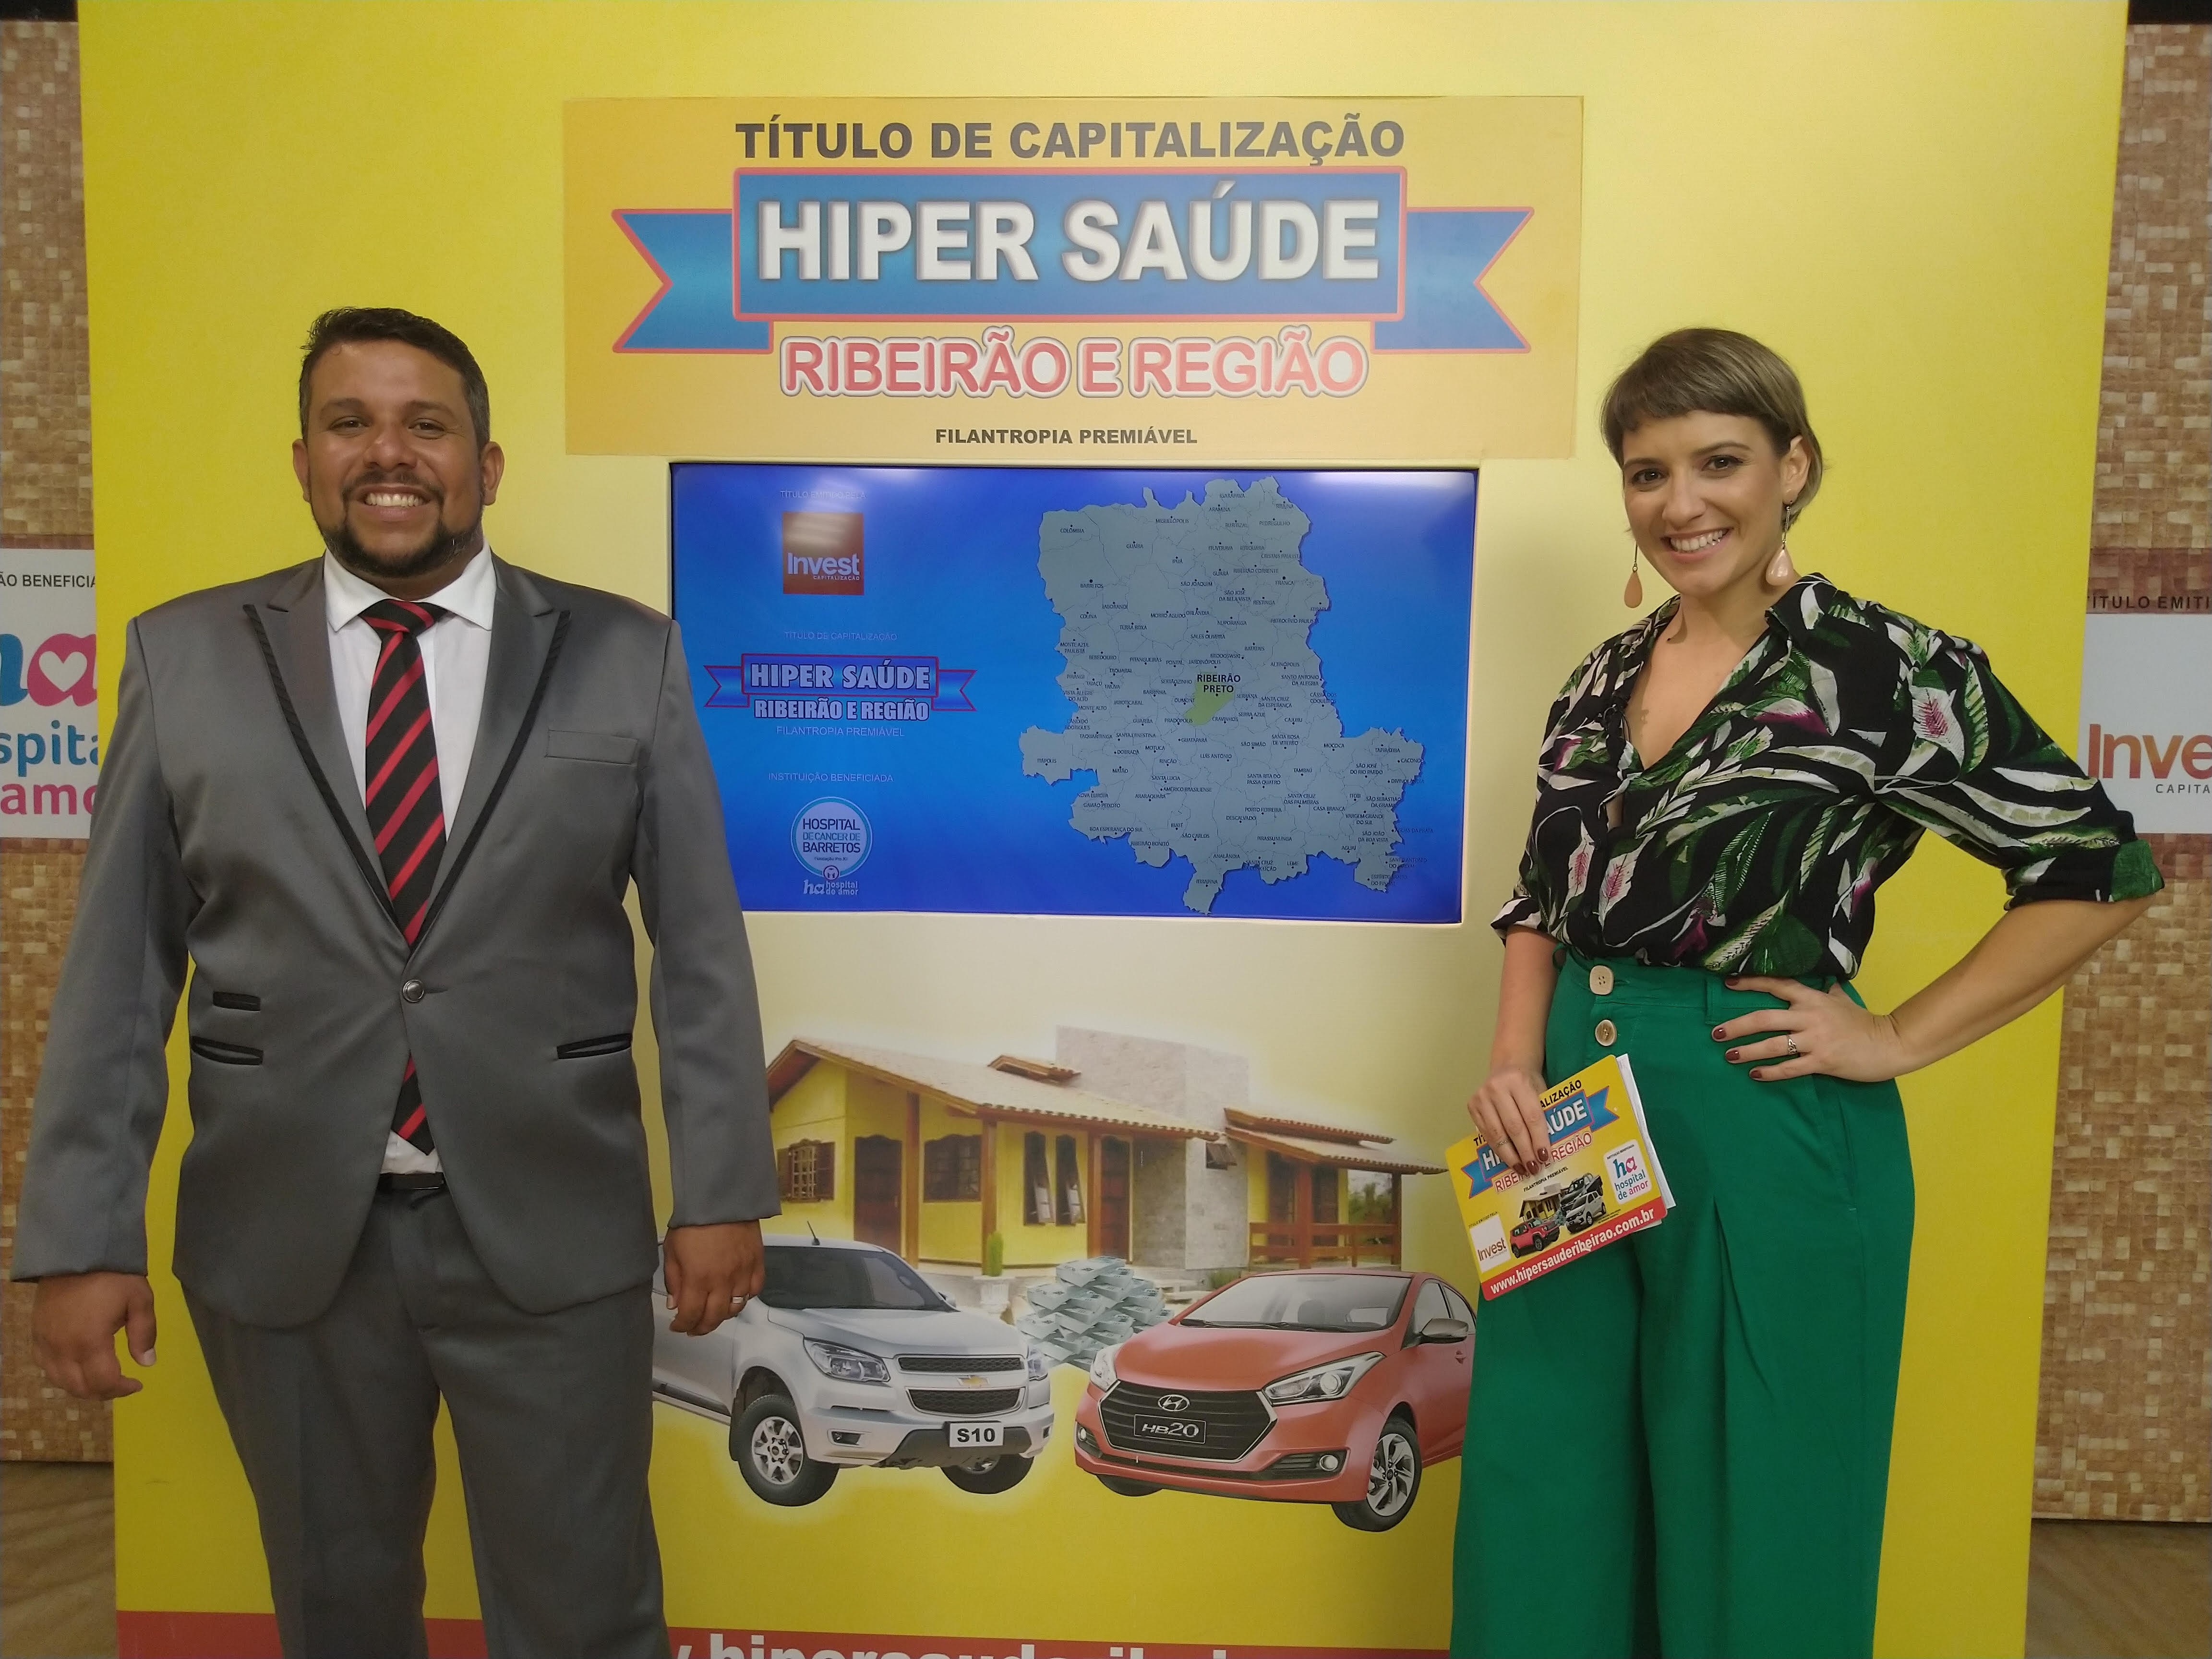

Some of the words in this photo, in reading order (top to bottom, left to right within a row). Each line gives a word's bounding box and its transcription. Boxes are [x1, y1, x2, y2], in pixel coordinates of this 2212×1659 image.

[735, 116, 913, 159] TÍTULO
[931, 121, 991, 159] DE
[1010, 113, 1405, 167] CAPITALIZAÇÃO
[759, 199, 1040, 282] HIPER
[1062, 180, 1378, 282] SAÚDE
[781, 324, 1068, 397] RIBEIRÃO
[1079, 337, 1121, 395] E
[1130, 324, 1368, 398] REGIÃO
[936, 428, 1072, 445] FILANTROPIA
[1079, 426, 1197, 444] PREMIÁVEL
[788, 553, 860, 576] Invest
[2088, 593, 2150, 608] ÍTULO
[831, 632, 897, 642] CAPITALIZAÇÃO
[751, 663, 833, 688] HIPER
[842, 660, 930, 690] SAÚDE
[1197, 673, 1240, 682] RIBEIRÃO
[755, 697, 842, 720] RIBEIRÃO
[846, 701, 857, 720] E
[861, 698, 928, 721] REGIÃO
[777, 727, 843, 736] FILANTROPIA
[847, 726, 904, 737] PREMIÁVEL
[769, 772, 828, 783] INSTITUIÇÃO
[831, 773, 893, 782] BENEFICIADA
[803, 818, 860, 830] HOSPITAL
[803, 842, 860, 853] BARRETOS
[826, 880, 857, 890] hospital
[1540, 1080, 1581, 1107] ALIZAÇÃO
[1551, 1131, 1592, 1163] REGIÃO
[1613, 1156, 1637, 1178] ha
[1615, 1169, 1646, 1190] hospital
[1618, 1191, 1627, 1200] de
[1629, 1181, 1647, 1195] amor
[1478, 1238, 1506, 1261] Invest
[1491, 1207, 1654, 1294] www.hipersauderibeirao.com.br
[956, 1426, 997, 1444] S10
[1141, 1421, 1200, 1438] HB20
